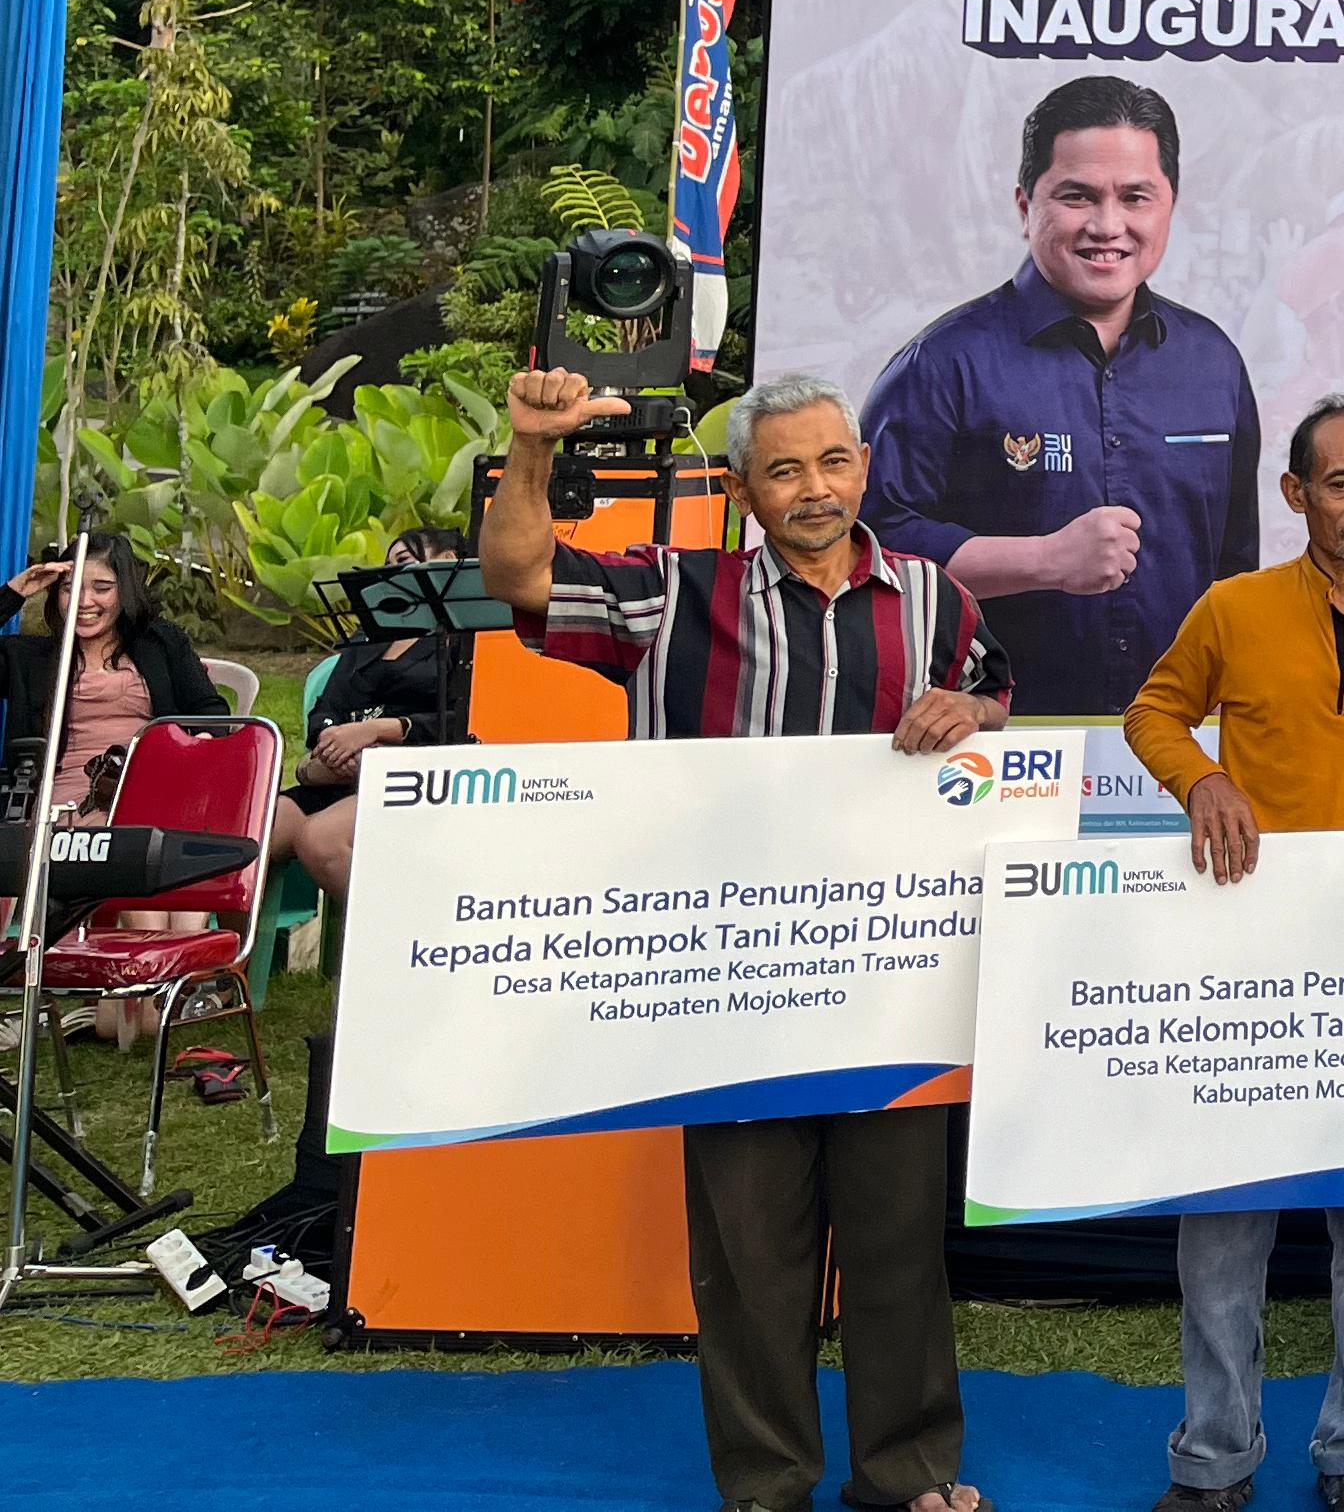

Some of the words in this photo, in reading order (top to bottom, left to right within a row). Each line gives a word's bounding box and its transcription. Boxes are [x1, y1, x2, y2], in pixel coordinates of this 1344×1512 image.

[1001, 749, 1063, 781] BRI
[384, 767, 517, 807] BUMN
[520, 790, 594, 802] INDONESIA
[521, 777, 569, 789] UNTUK
[1000, 782, 1059, 802] peduli
[1096, 775, 1143, 797] BNI
[50, 831, 112, 862] ORG
[1004, 860, 1119, 897] BUMN
[1122, 881, 1187, 893] INDONESIA
[1123, 870, 1165, 881] UNTUK
[455, 894, 592, 921] Bantuan
[602, 886, 709, 914] Sarana
[719, 876, 885, 909] Penunjang
[895, 869, 983, 898] Usaha
[410, 934, 531, 972] kepada
[542, 923, 707, 961] Kelompok
[714, 920, 781, 950] Tani
[789, 916, 858, 950] Kopi
[867, 909, 982, 941] Dlundu
[492, 974, 552, 995] Desa
[559, 966, 721, 993] Ketapanrame
[727, 956, 855, 980] Kecamatan
[861, 952, 939, 972] Trawas
[589, 996, 720, 1022] Kabupaten
[726, 987, 846, 1015] Mojokerto
[1071, 980, 1190, 1006] Bantuan
[1199, 974, 1294, 1001] Sarana
[1044, 1018, 1149, 1054] kepada
[1159, 1011, 1304, 1046] Kelompok
[1106, 1057, 1158, 1077] Desa
[1165, 1053, 1308, 1077] Ketapanrame
[1192, 1082, 1309, 1106] Kabupaten
